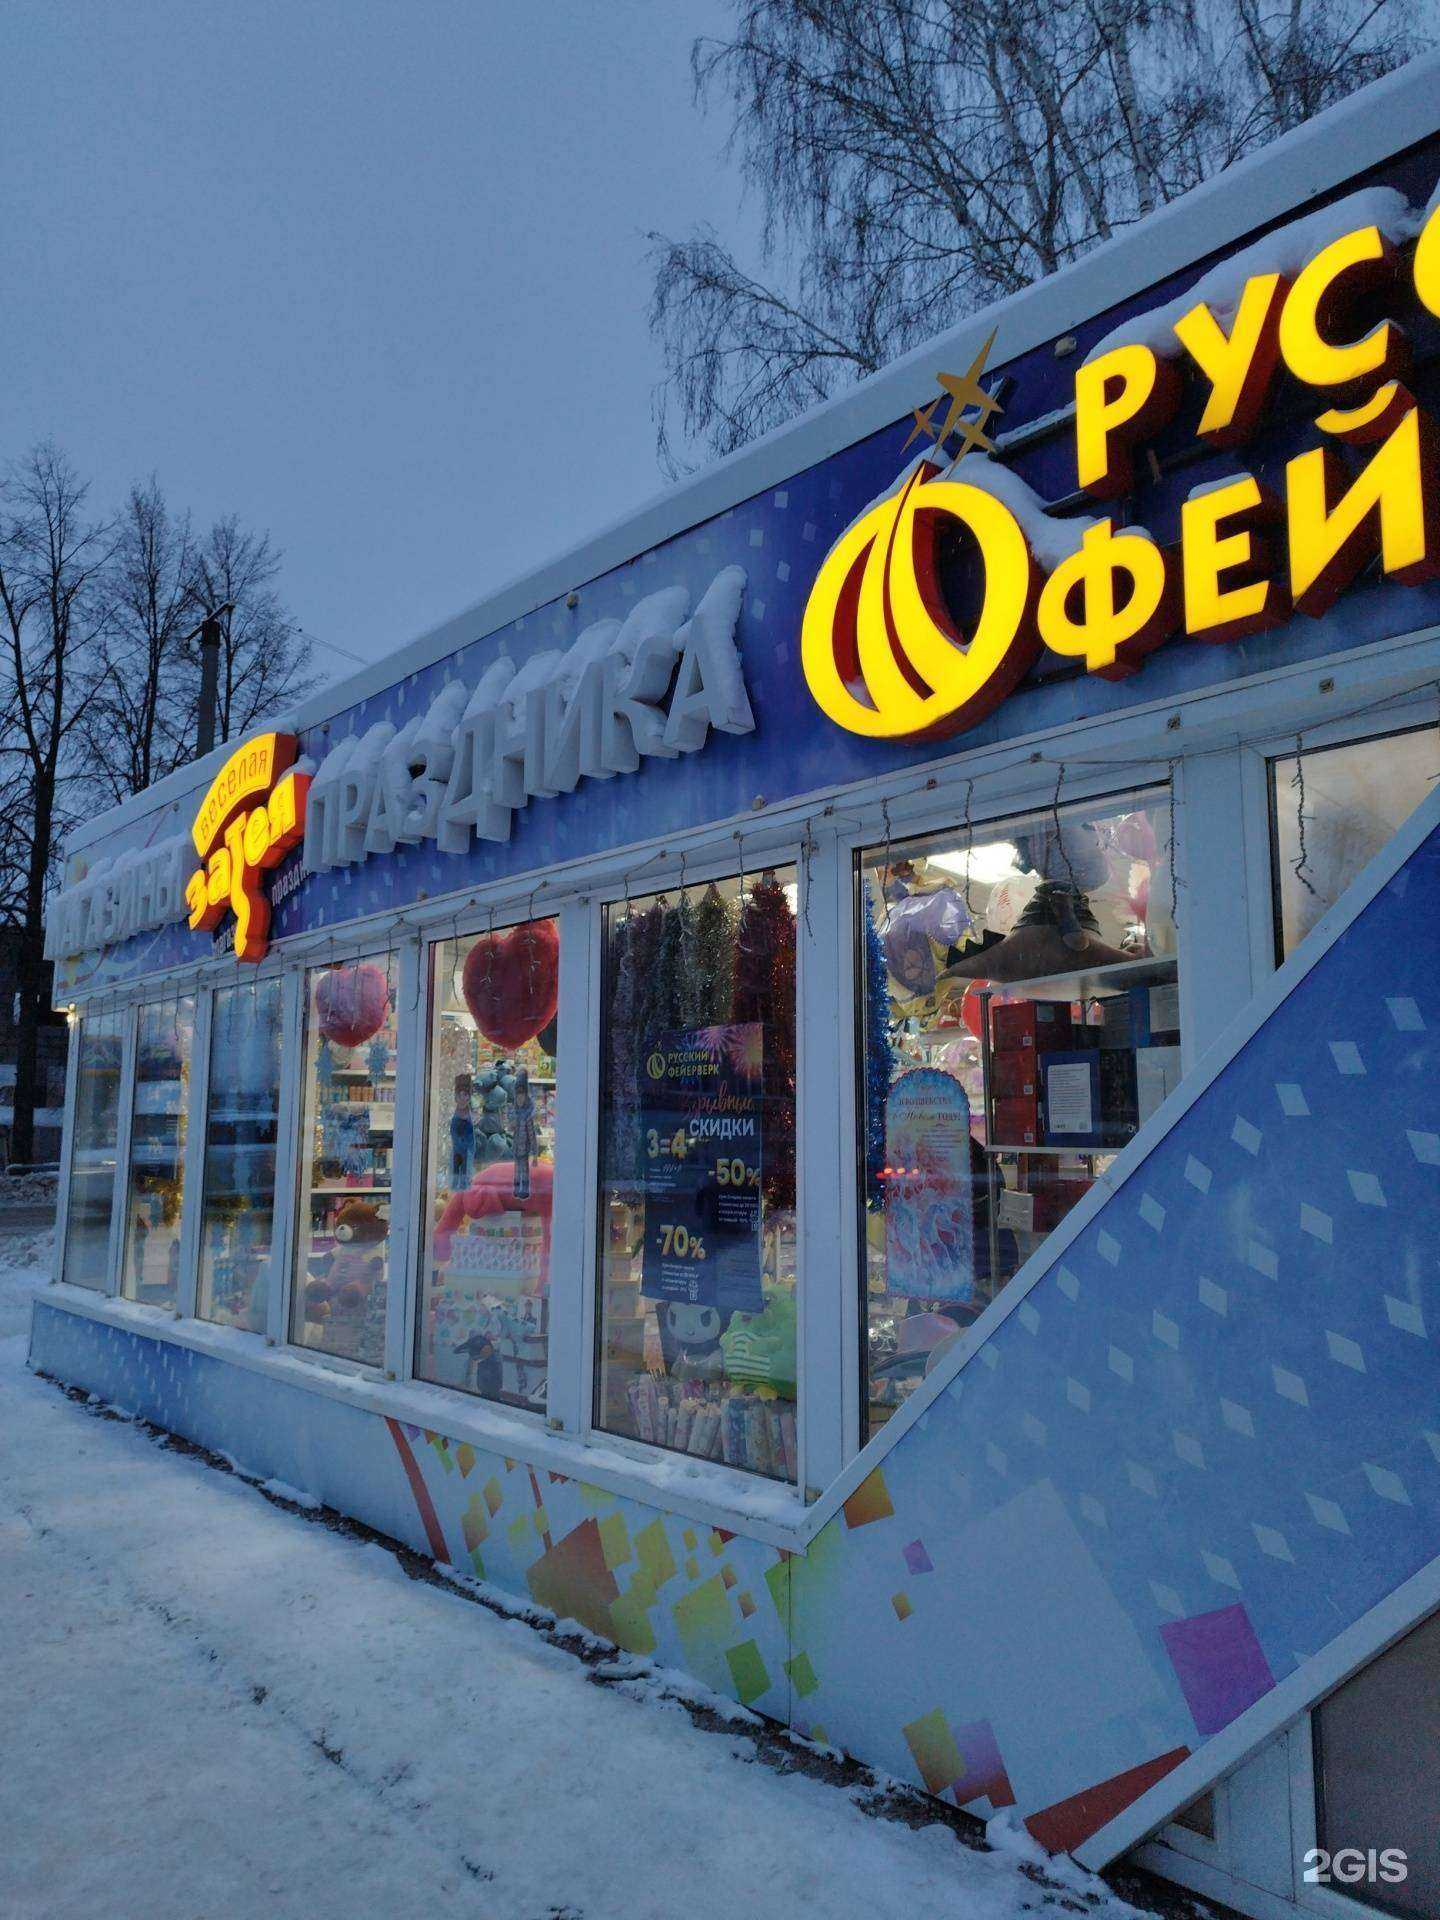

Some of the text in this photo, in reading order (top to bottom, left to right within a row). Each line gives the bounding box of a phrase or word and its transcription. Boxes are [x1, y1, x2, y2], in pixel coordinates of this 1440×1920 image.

[1037, 381, 1426, 674] ФЕЙ
[303, 568, 756, 873] ПРАЗДНИКА
[667, 1049, 710, 1064] РУССКИЙ
[667, 1063, 720, 1078] ФЕЙЕРВЕРК
[689, 1117, 755, 1140] СКИДКИ
[656, 1224, 706, 1260] -70%
